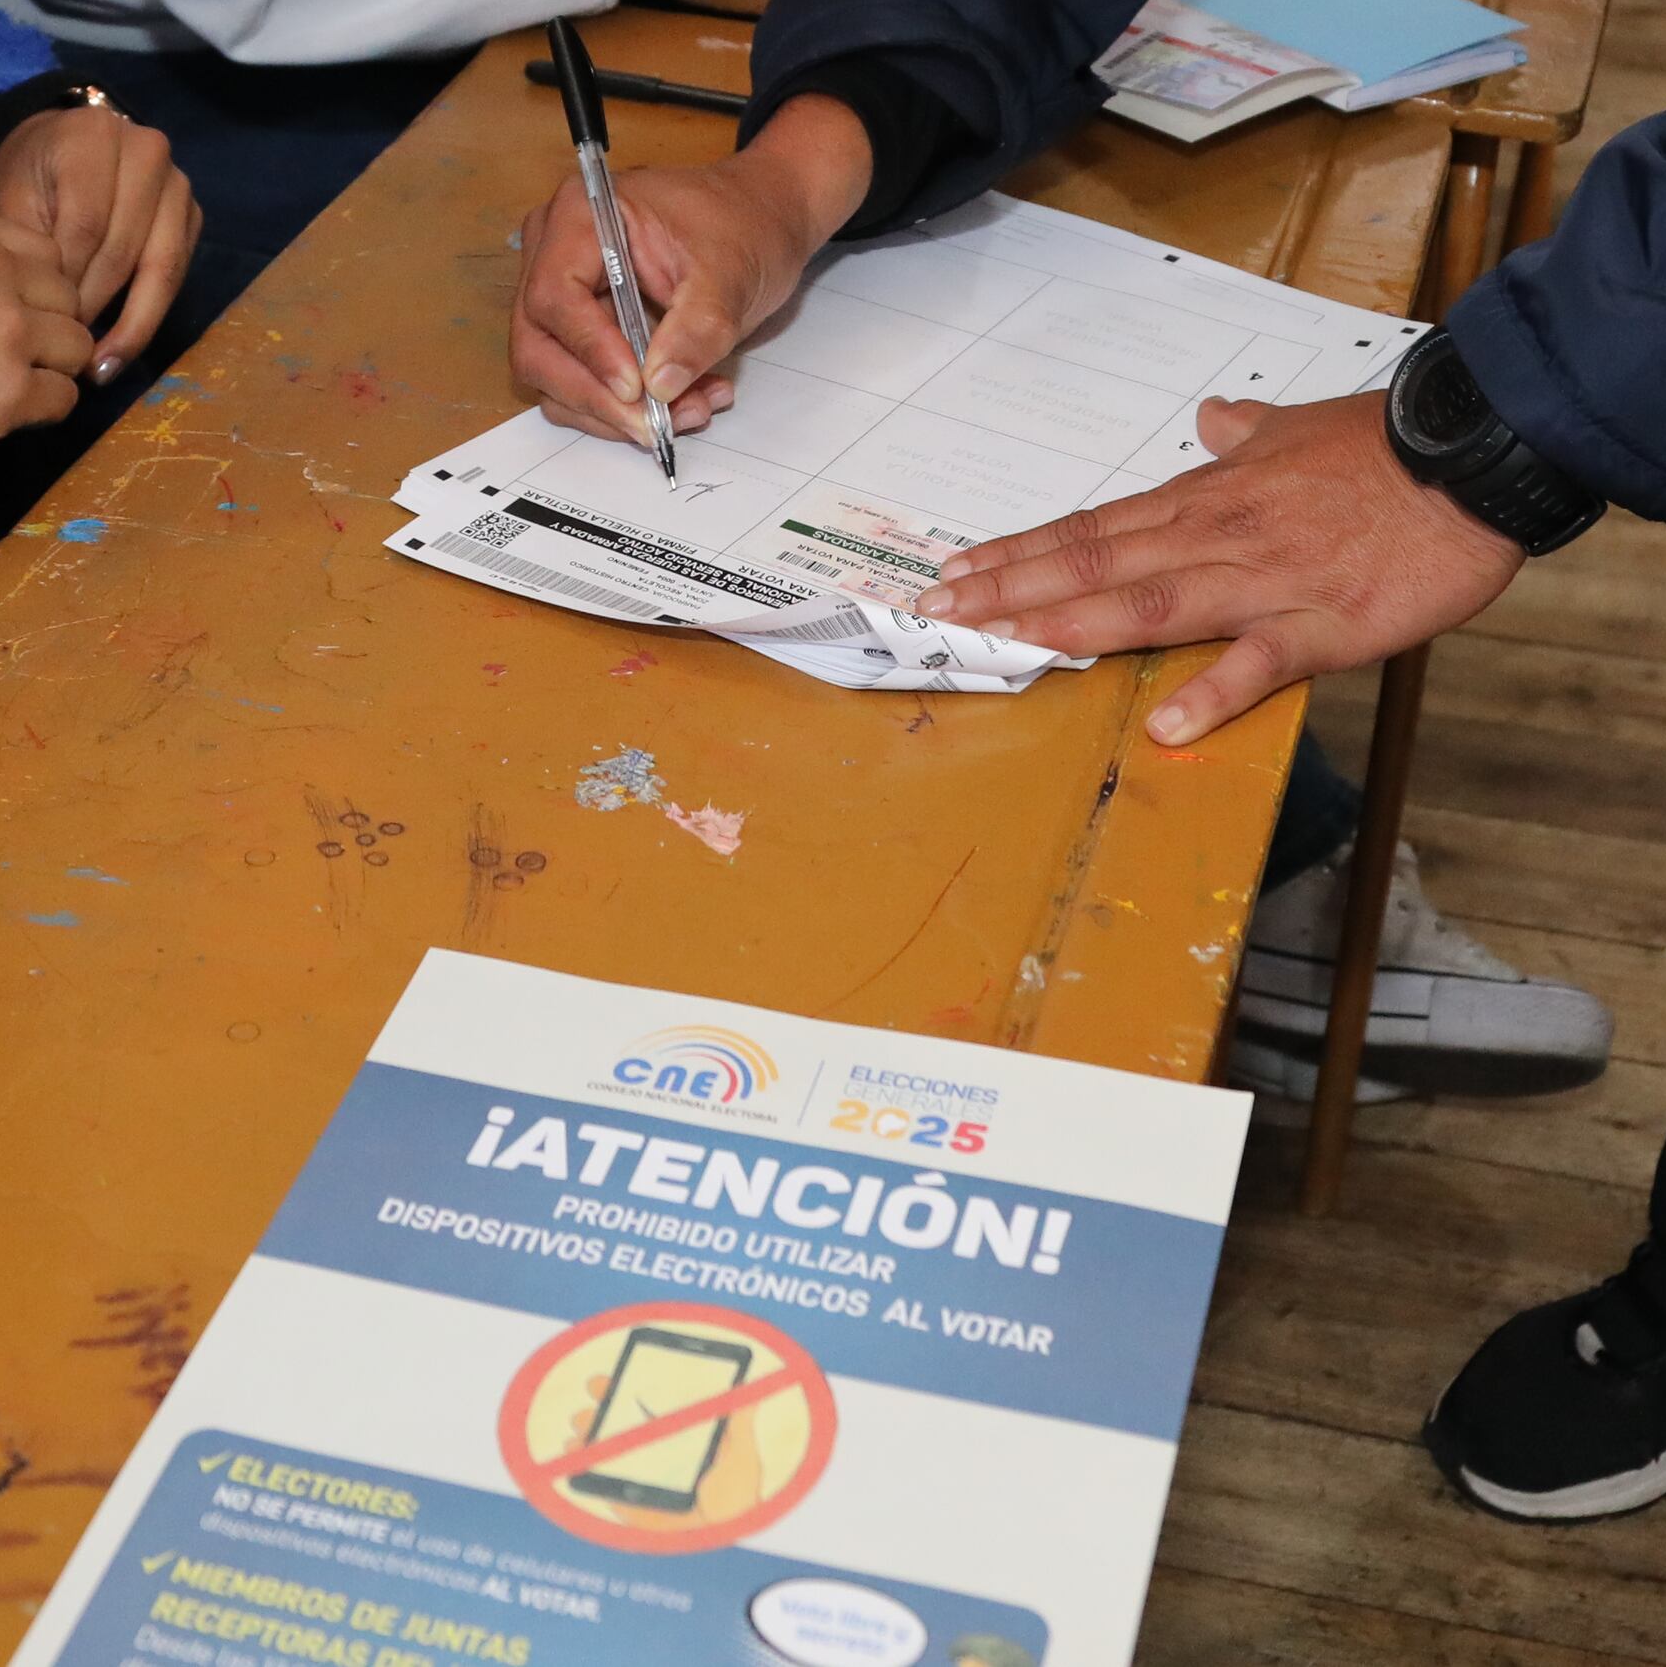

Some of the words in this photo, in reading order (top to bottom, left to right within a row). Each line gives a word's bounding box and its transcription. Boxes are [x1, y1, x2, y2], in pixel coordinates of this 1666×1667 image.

[1249, 372, 1264, 383] 4
[1179, 440, 1194, 452] 3
[522, 489, 589, 518] DACTILAR
[548, 521, 561, 530] Y
[560, 524, 623, 551] ARMADAS
[590, 514, 642, 537] HUELLA
[617, 535, 665, 557] ACTIVO
[656, 537, 698, 554] FIRMA
[796, 544, 833, 559] VOTAR
[812, 530, 884, 558] ARMADAS
[622, 545, 681, 572] FUERZAS
[663, 553, 723, 578] SERVICIO
[835, 556, 865, 570] PARA
[883, 554, 937, 579] UERZAS
[680, 567, 708, 581] LAS
[707, 574, 727, 588] DE
[723, 573, 743, 584] EN
[738, 565, 784, 586] VOTAR
[867, 567, 926, 592] REDENCIAL
[726, 584, 789, 609] IEMBROS
[745, 580, 803, 604] ACIONAL
[788, 583, 821, 598] ARA
[849, 1064, 999, 1105] ELECCIONES
[843, 1082, 994, 1121] GENERALES
[829, 1099, 989, 1154] 2025
[465, 1105, 1073, 1276] ¡ATENCIÓN!
[553, 1193, 738, 1254] PROHIBIDO
[743, 1231, 897, 1284] UTILIZAR
[377, 1197, 607, 1266] DISPOSITIVOS
[608, 1241, 871, 1318] ELECTRÓNICOS
[881, 1297, 931, 1332] AL
[940, 1306, 1055, 1357] VOTAR
[227, 1454, 420, 1522] ELECTORES:
[211, 1484, 254, 1512] NO
[251, 1493, 287, 1521] SE
[284, 1502, 391, 1544] PERMITE
[170, 1555, 349, 1623] MIEMBROS
[350, 1598, 402, 1637] DE
[400, 1612, 532, 1667] JUNTAS
[149, 1591, 372, 1667] RECEPTORAS
